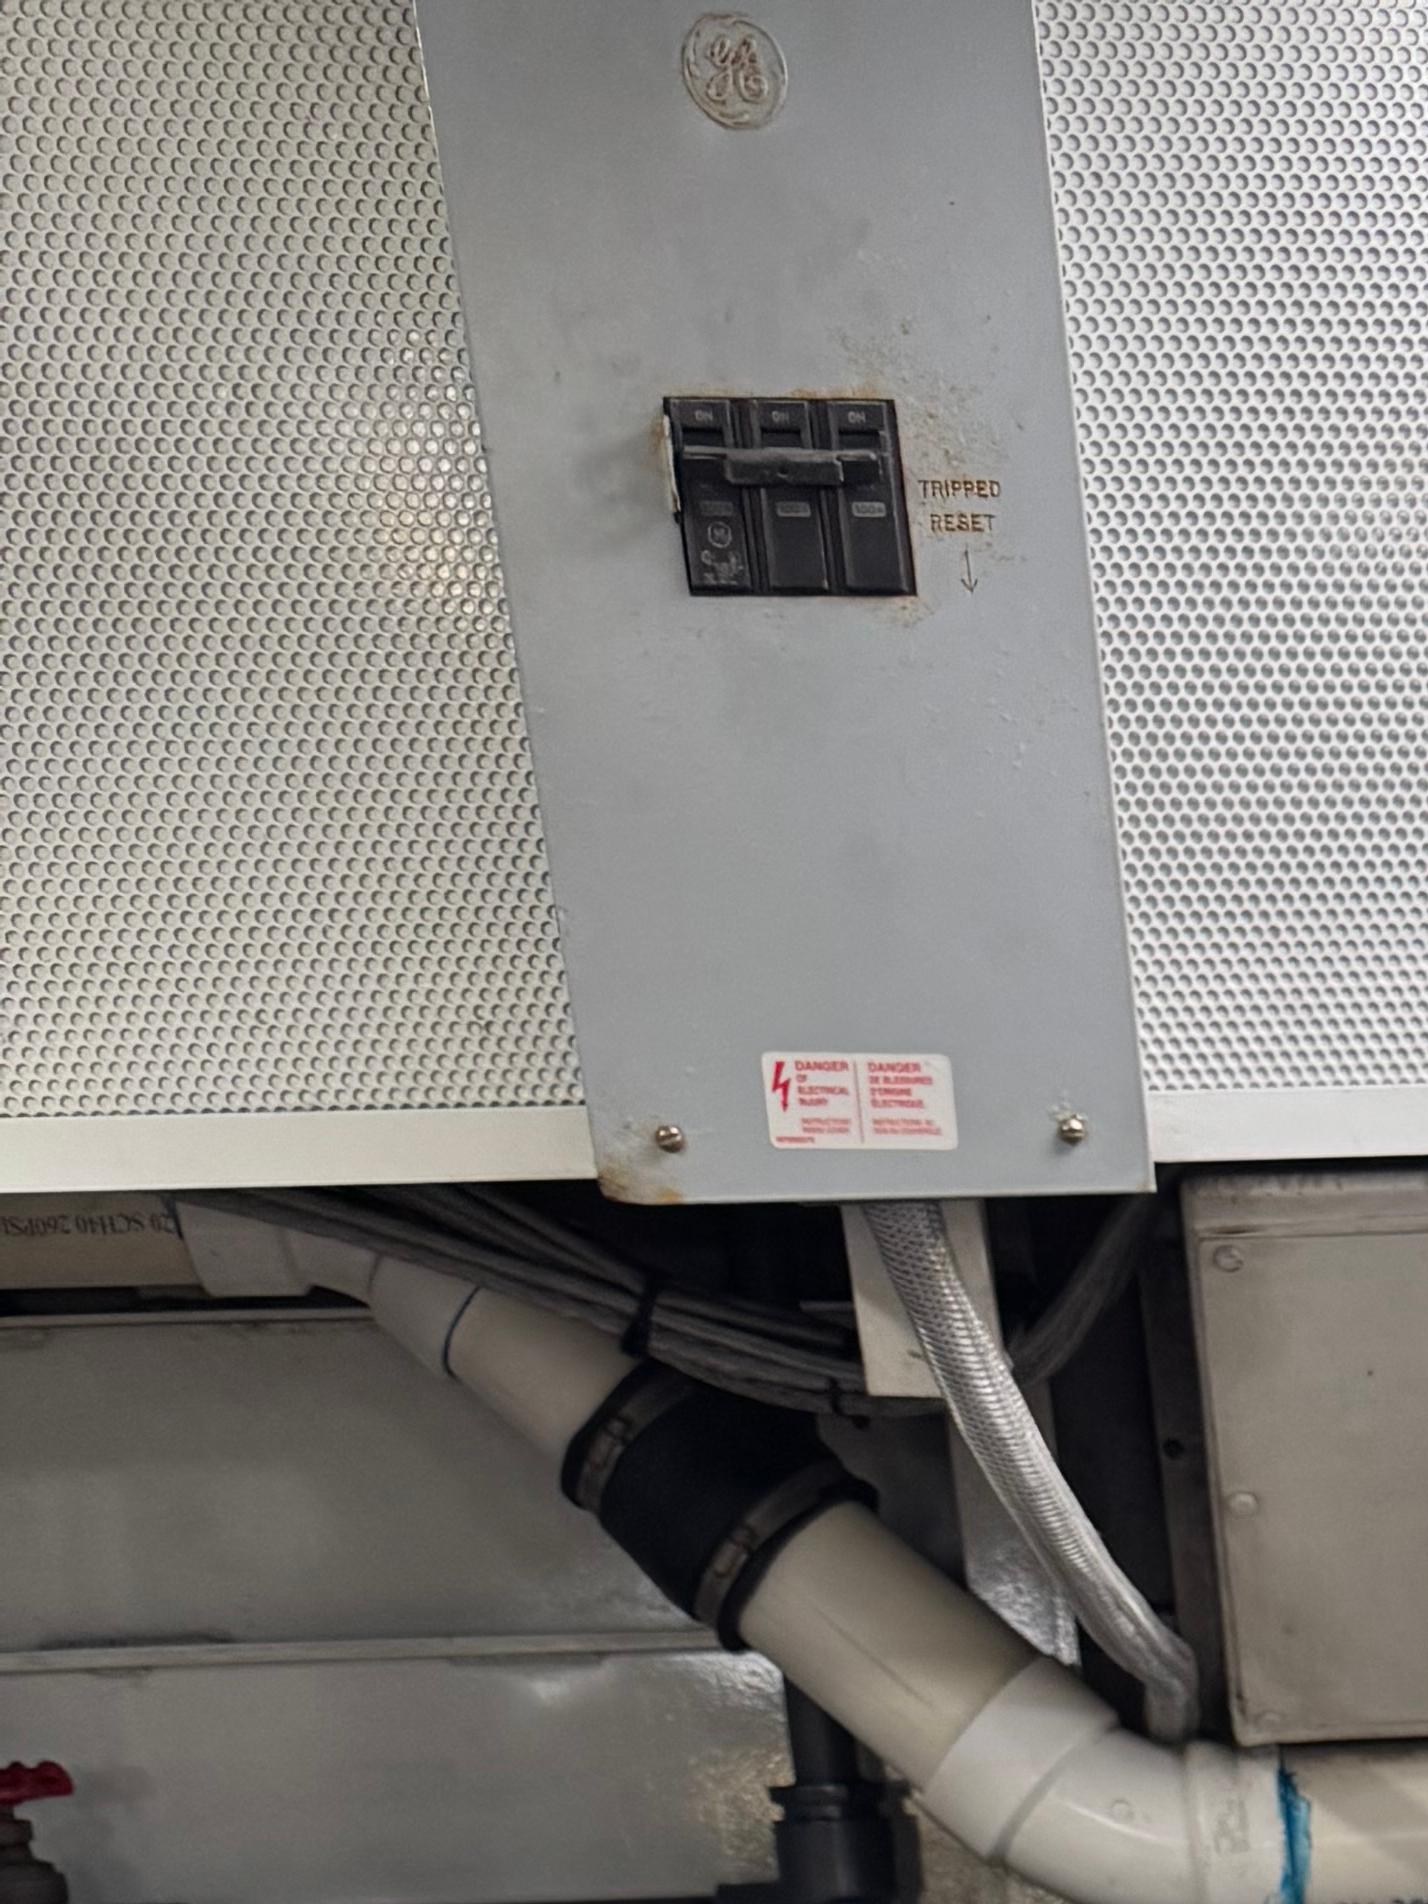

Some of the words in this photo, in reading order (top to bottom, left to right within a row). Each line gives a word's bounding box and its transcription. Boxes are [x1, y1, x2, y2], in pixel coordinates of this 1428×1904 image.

[917, 479, 1001, 498] TRIPPED
[930, 513, 996, 533] RESET
[794, 1060, 849, 1072] DANGER
[867, 1062, 921, 1073] DANGER
